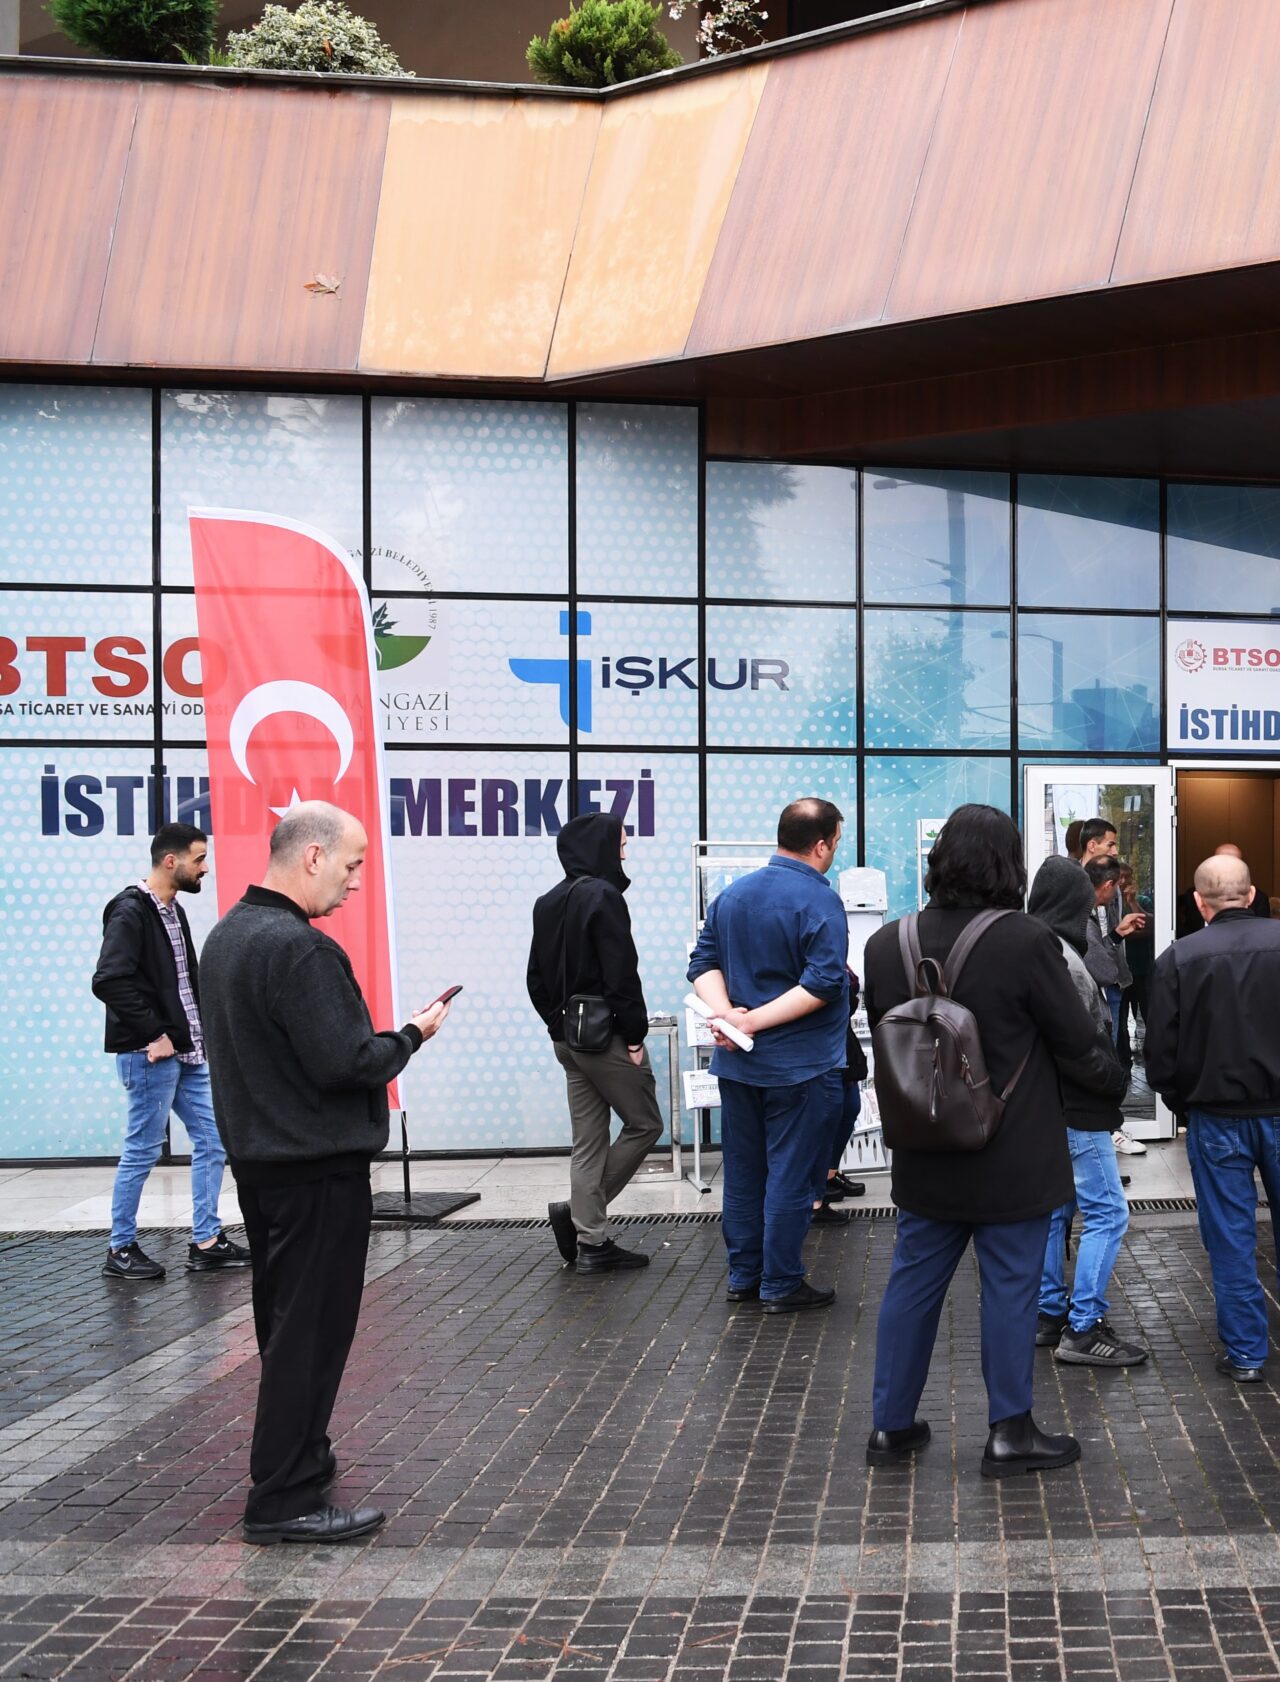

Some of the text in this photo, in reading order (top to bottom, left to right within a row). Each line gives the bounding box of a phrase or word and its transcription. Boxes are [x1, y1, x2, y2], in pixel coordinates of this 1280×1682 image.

[20, 700, 85, 716] TİCARET
[89, 703, 109, 716] VE
[113, 701, 176, 716] SANAYİ
[390, 769, 656, 837] MERKEZİ
